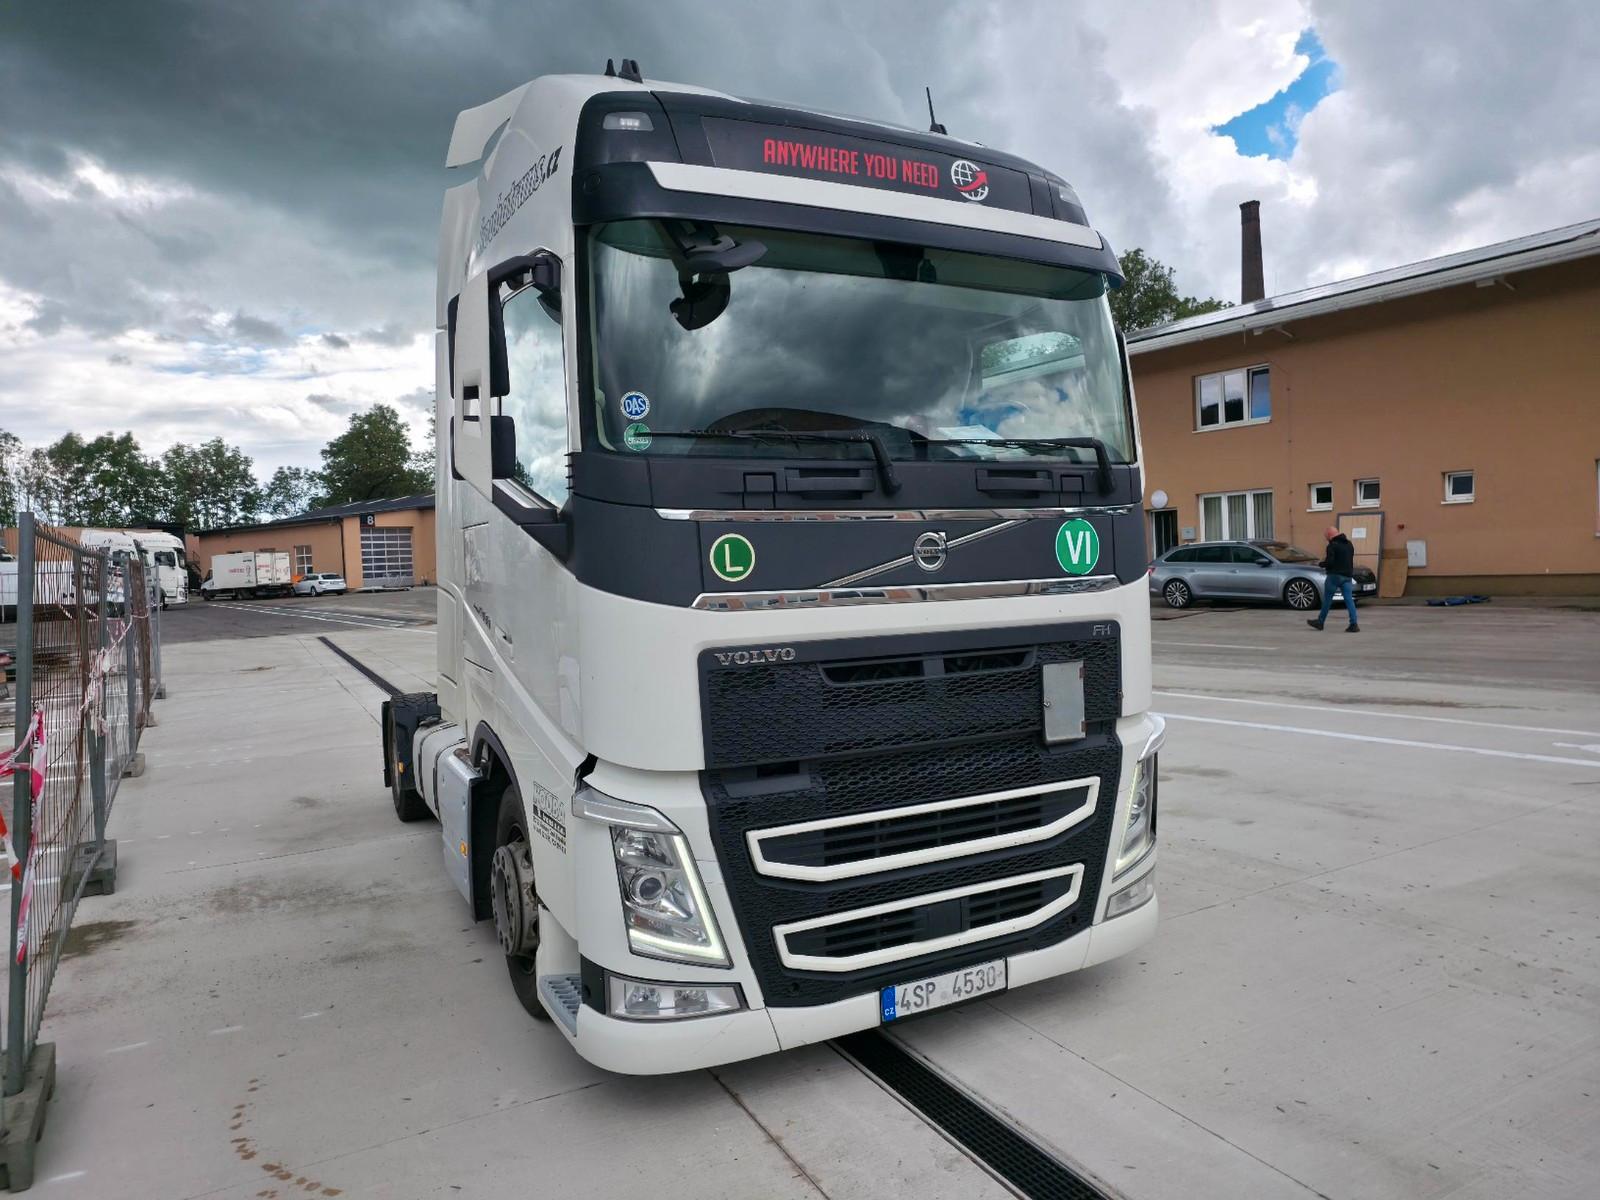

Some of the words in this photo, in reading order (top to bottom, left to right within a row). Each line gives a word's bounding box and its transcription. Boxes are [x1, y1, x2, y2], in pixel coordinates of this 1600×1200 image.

[763, 139, 858, 175] ANYWHERE
[864, 153, 897, 180] YOU
[902, 159, 939, 188] NEED
[367, 515, 374, 525] 8
[724, 543, 744, 572] L
[1065, 530, 1091, 565] VI
[714, 647, 796, 665] VOLVO
[900, 981, 936, 1010] 4SP
[952, 965, 996, 997] 4530
[884, 1007, 895, 1016] CZ
